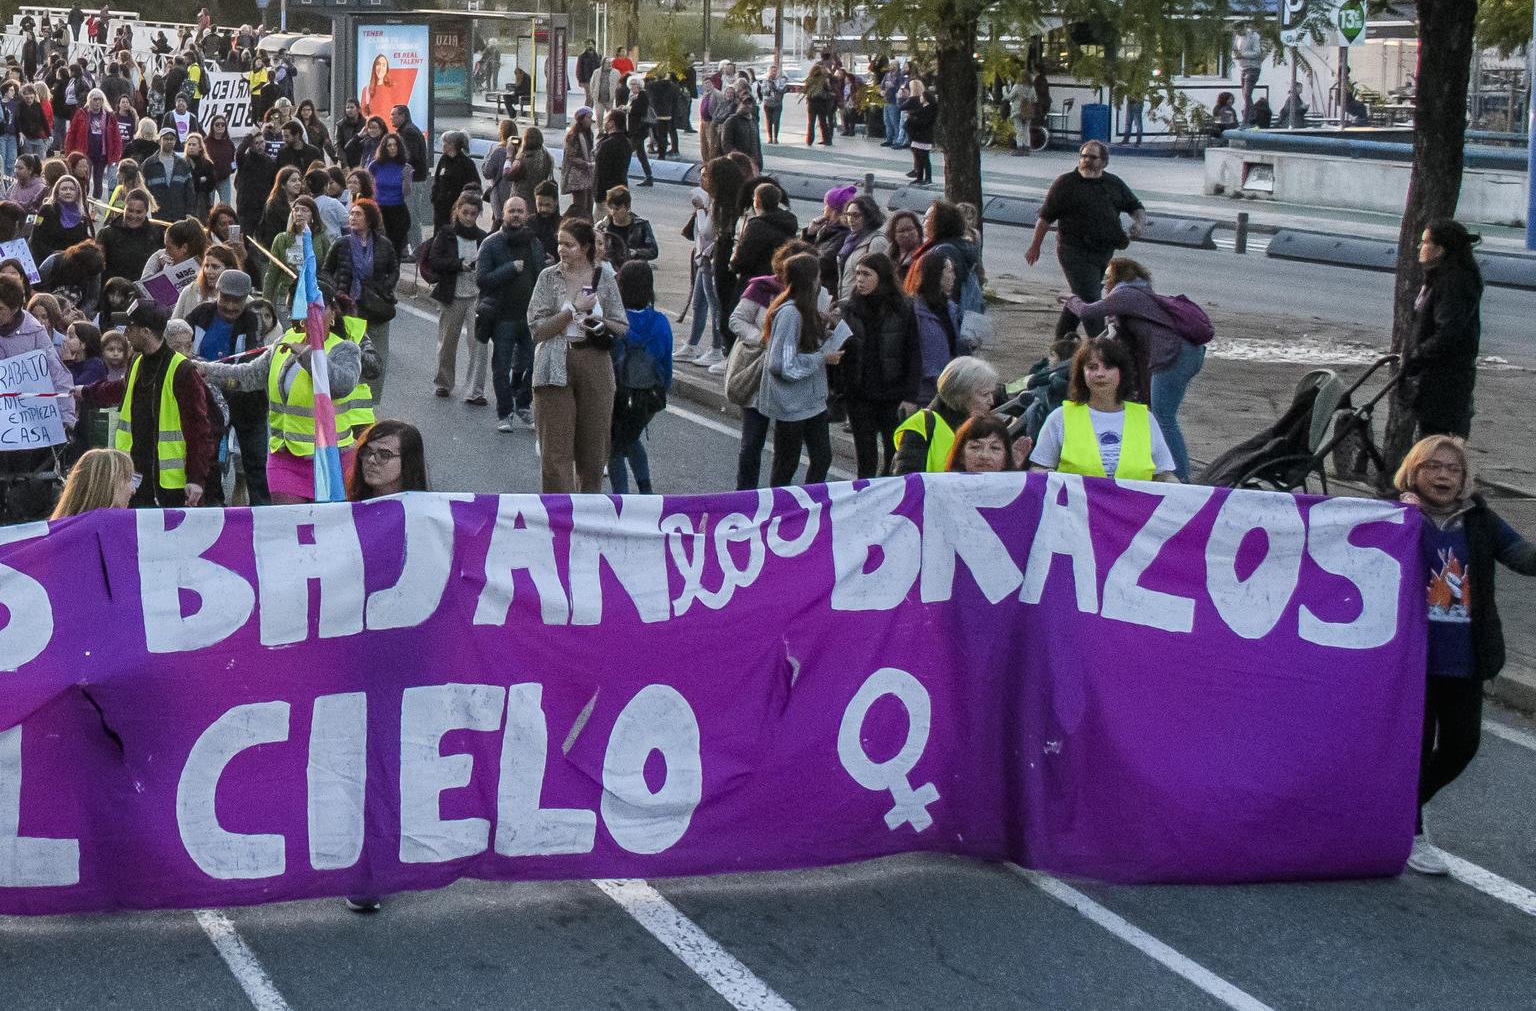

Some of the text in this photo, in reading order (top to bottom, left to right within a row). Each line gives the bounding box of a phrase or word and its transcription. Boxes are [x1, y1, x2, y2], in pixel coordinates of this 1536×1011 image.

[1, 426, 51, 444] CASA
[8, 404, 58, 424] EMPIEZA
[135, 492, 670, 654] BAJAN
[830, 472, 1407, 650] BRAZOS
[176, 682, 703, 880] CIELO
